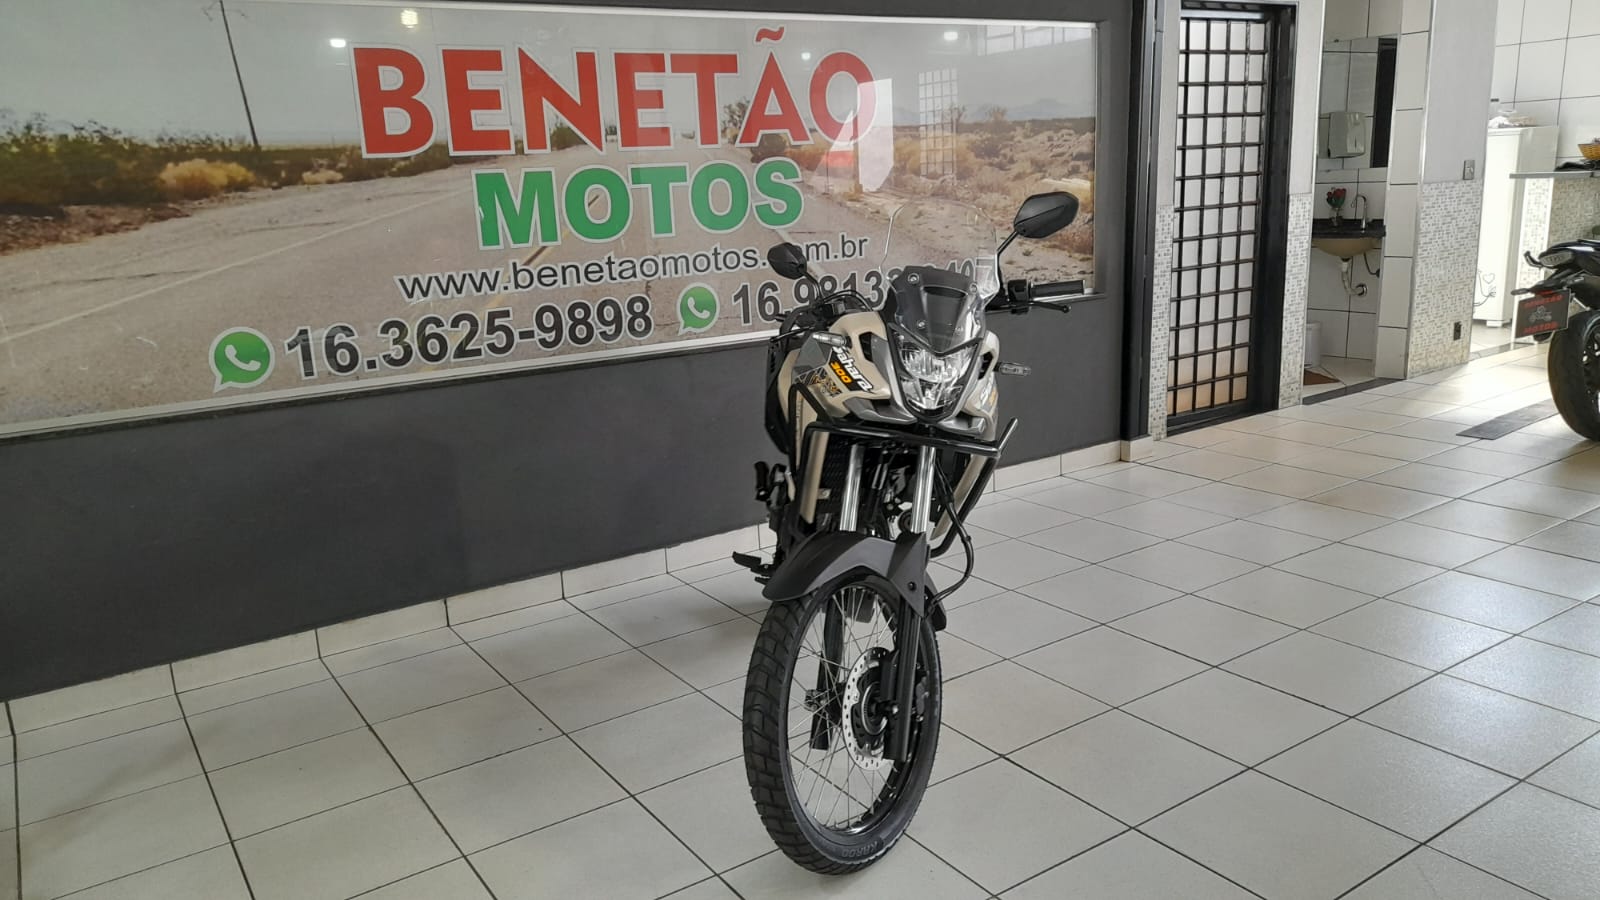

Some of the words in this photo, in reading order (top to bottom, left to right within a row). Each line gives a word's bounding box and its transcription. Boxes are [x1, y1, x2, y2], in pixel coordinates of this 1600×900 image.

[352, 26, 876, 156] BENETÃO
[476, 159, 802, 249] MOTOS
[397, 234, 868, 300] www.benetaomotos.m.br
[286, 295, 652, 378] 16.3625-9898
[830, 362, 852, 383] 300
